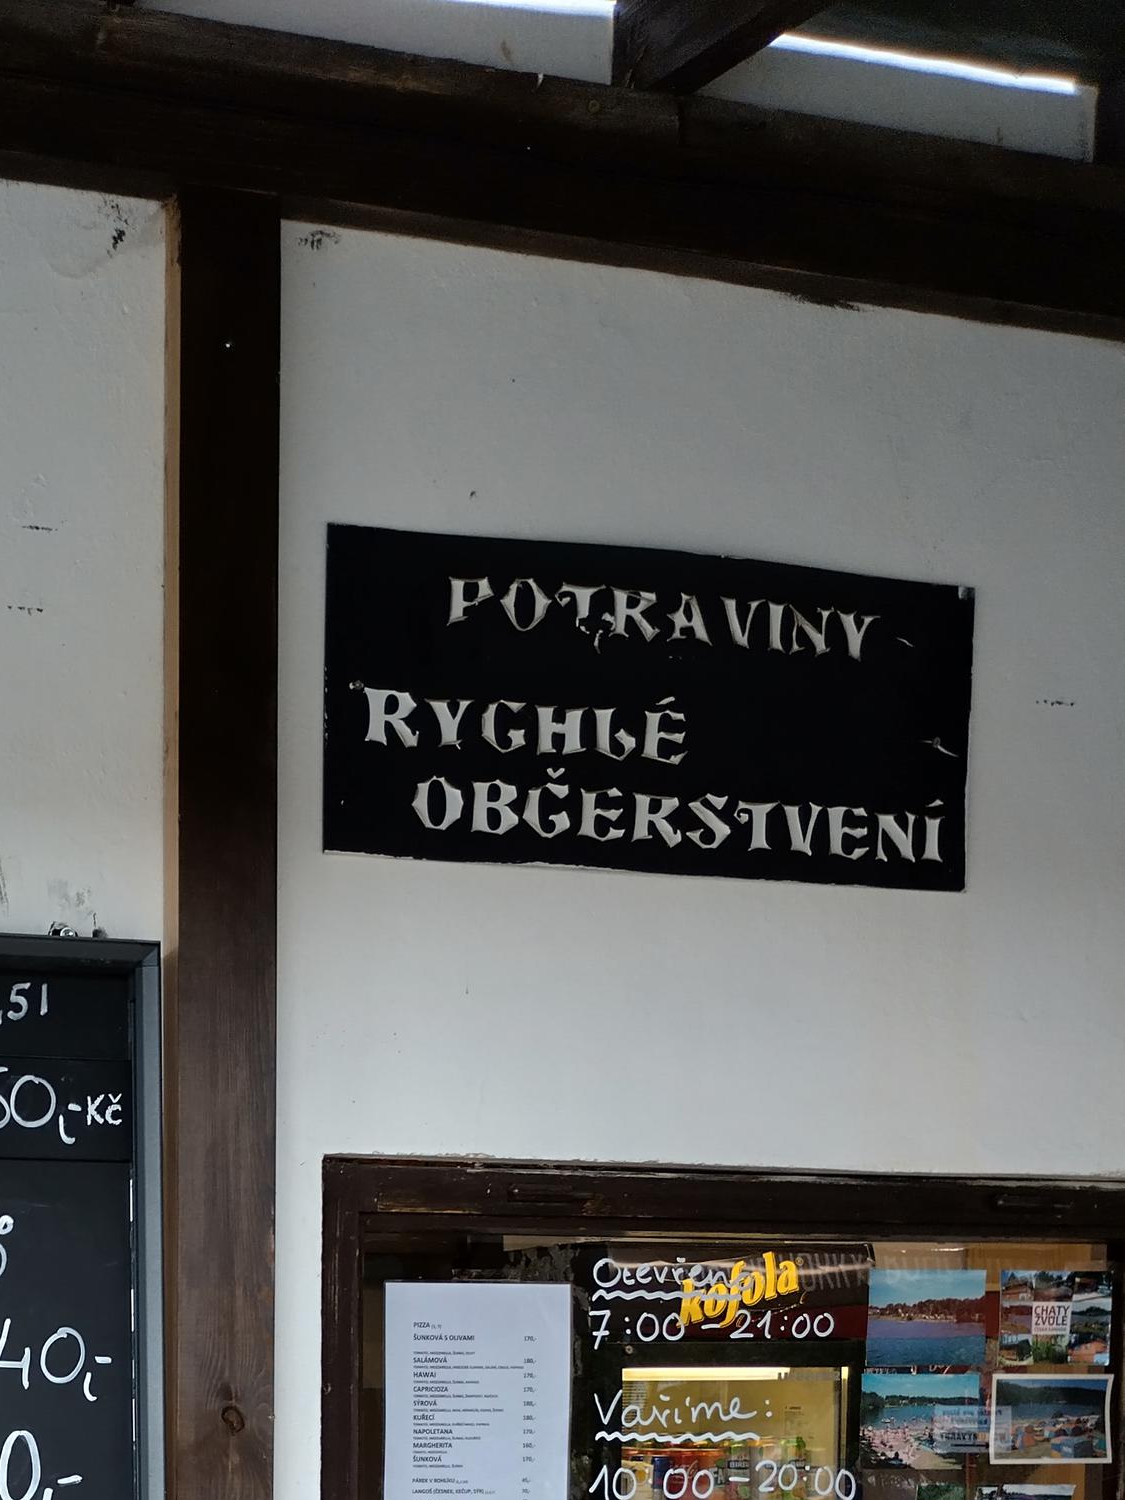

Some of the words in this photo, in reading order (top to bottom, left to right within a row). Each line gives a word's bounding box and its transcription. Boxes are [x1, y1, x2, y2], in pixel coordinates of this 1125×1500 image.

[443, 574, 885, 662] POTRAVINY
[363, 685, 690, 766] RYCHLÉ
[410, 766, 945, 864] OBČERSTVENÍ
[589, 1309, 686, 1350] 7:00
[729, 1309, 836, 1340] 21:00
[1034, 1305, 1070, 1316] CHATY
